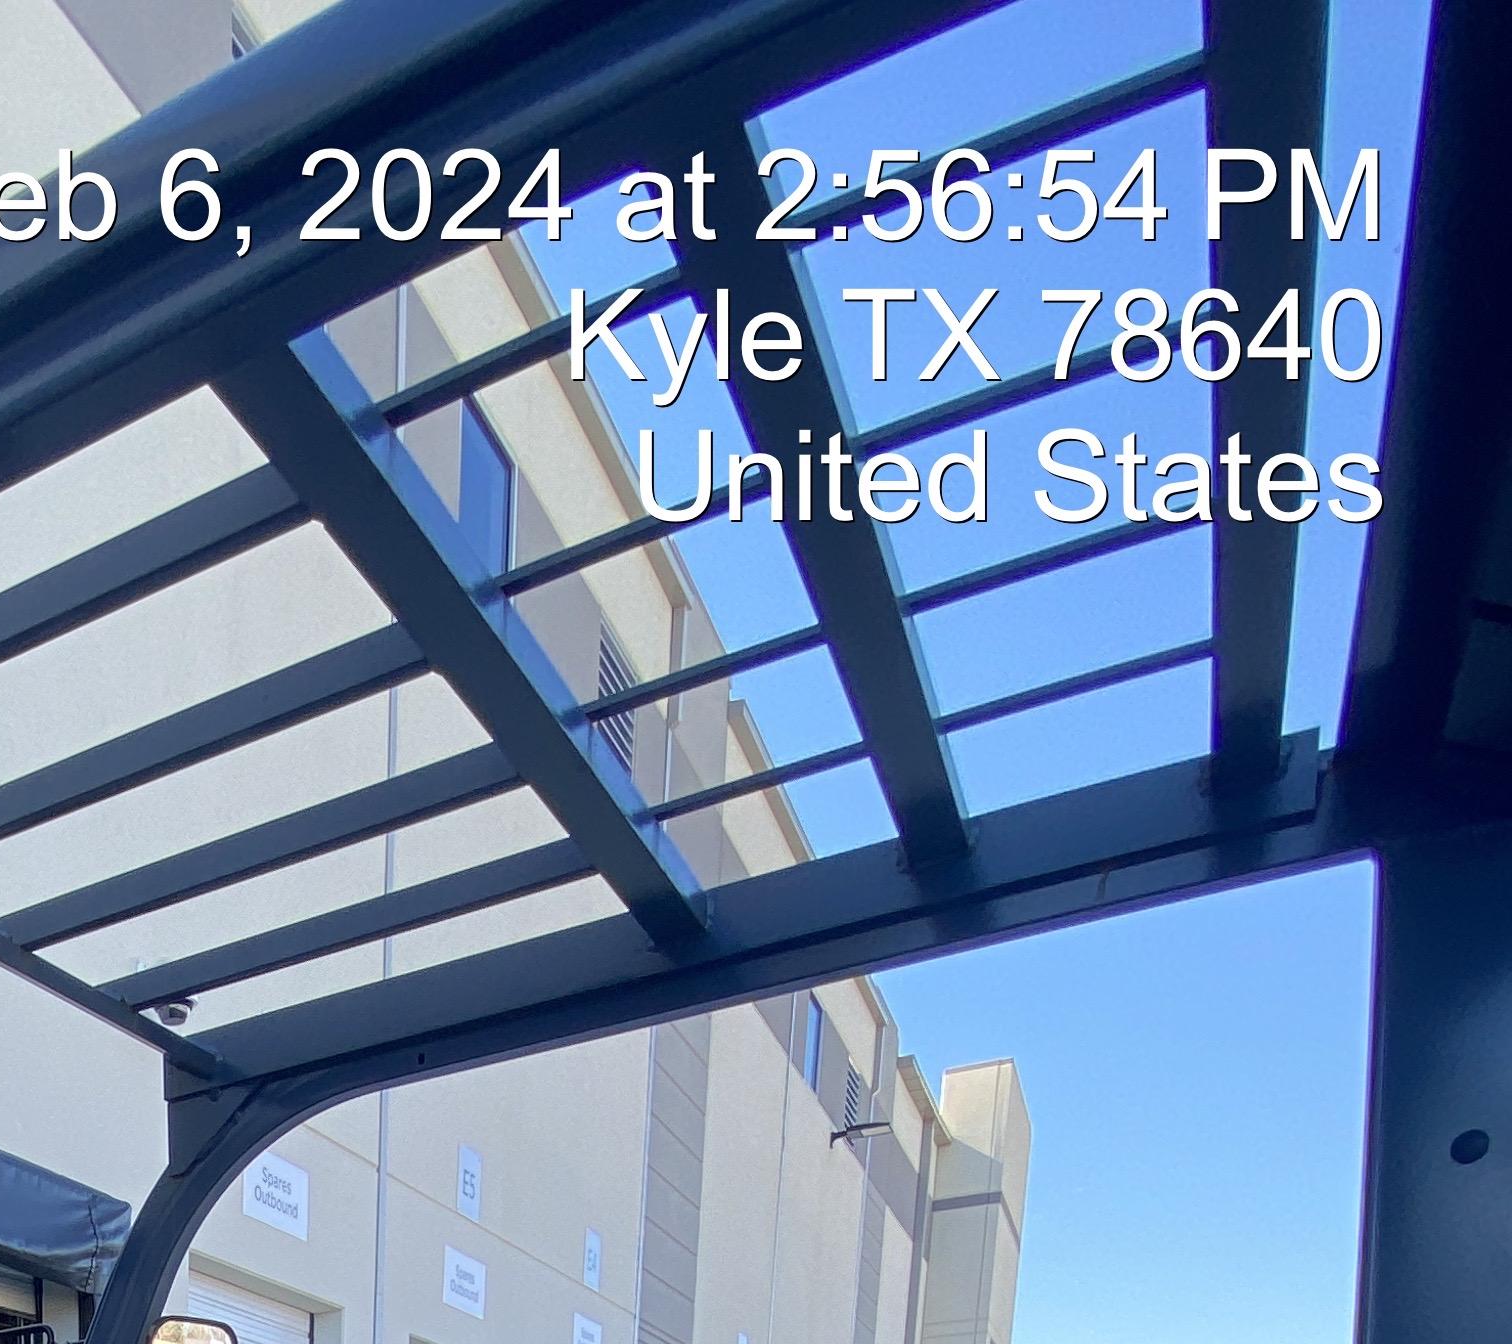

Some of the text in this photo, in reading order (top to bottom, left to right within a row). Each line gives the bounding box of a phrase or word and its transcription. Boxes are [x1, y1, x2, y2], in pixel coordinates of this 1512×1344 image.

[262, 1166, 292, 1195] Spares
[462, 1168, 476, 1200] E5
[254, 1184, 299, 1220] Outbound
